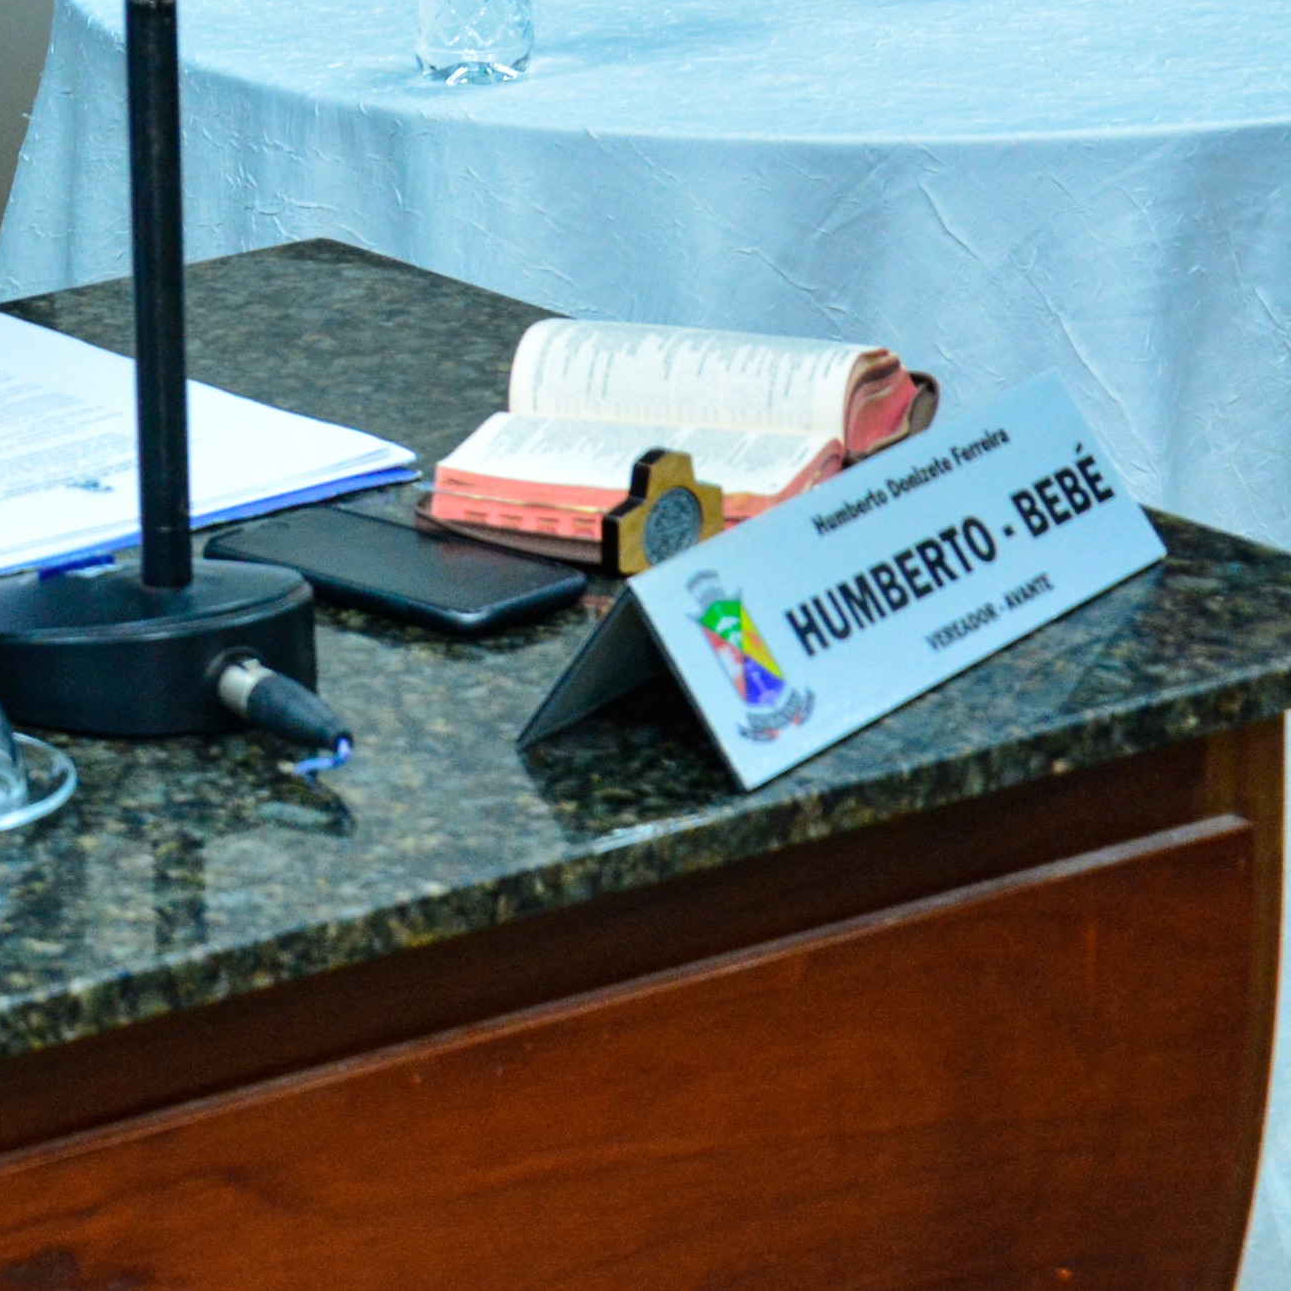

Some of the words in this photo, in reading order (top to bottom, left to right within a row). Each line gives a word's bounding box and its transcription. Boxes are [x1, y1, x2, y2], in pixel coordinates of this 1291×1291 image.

[811, 488, 888, 534] Humberto
[885, 458, 953, 498] Donizete
[950, 428, 1010, 466] Ferreira
[784, 515, 998, 656] HUMBERTO
[1010, 443, 1115, 538] BEBÉ
[926, 602, 999, 650] VEREADOR
[1004, 572, 1054, 610] AVANTE
